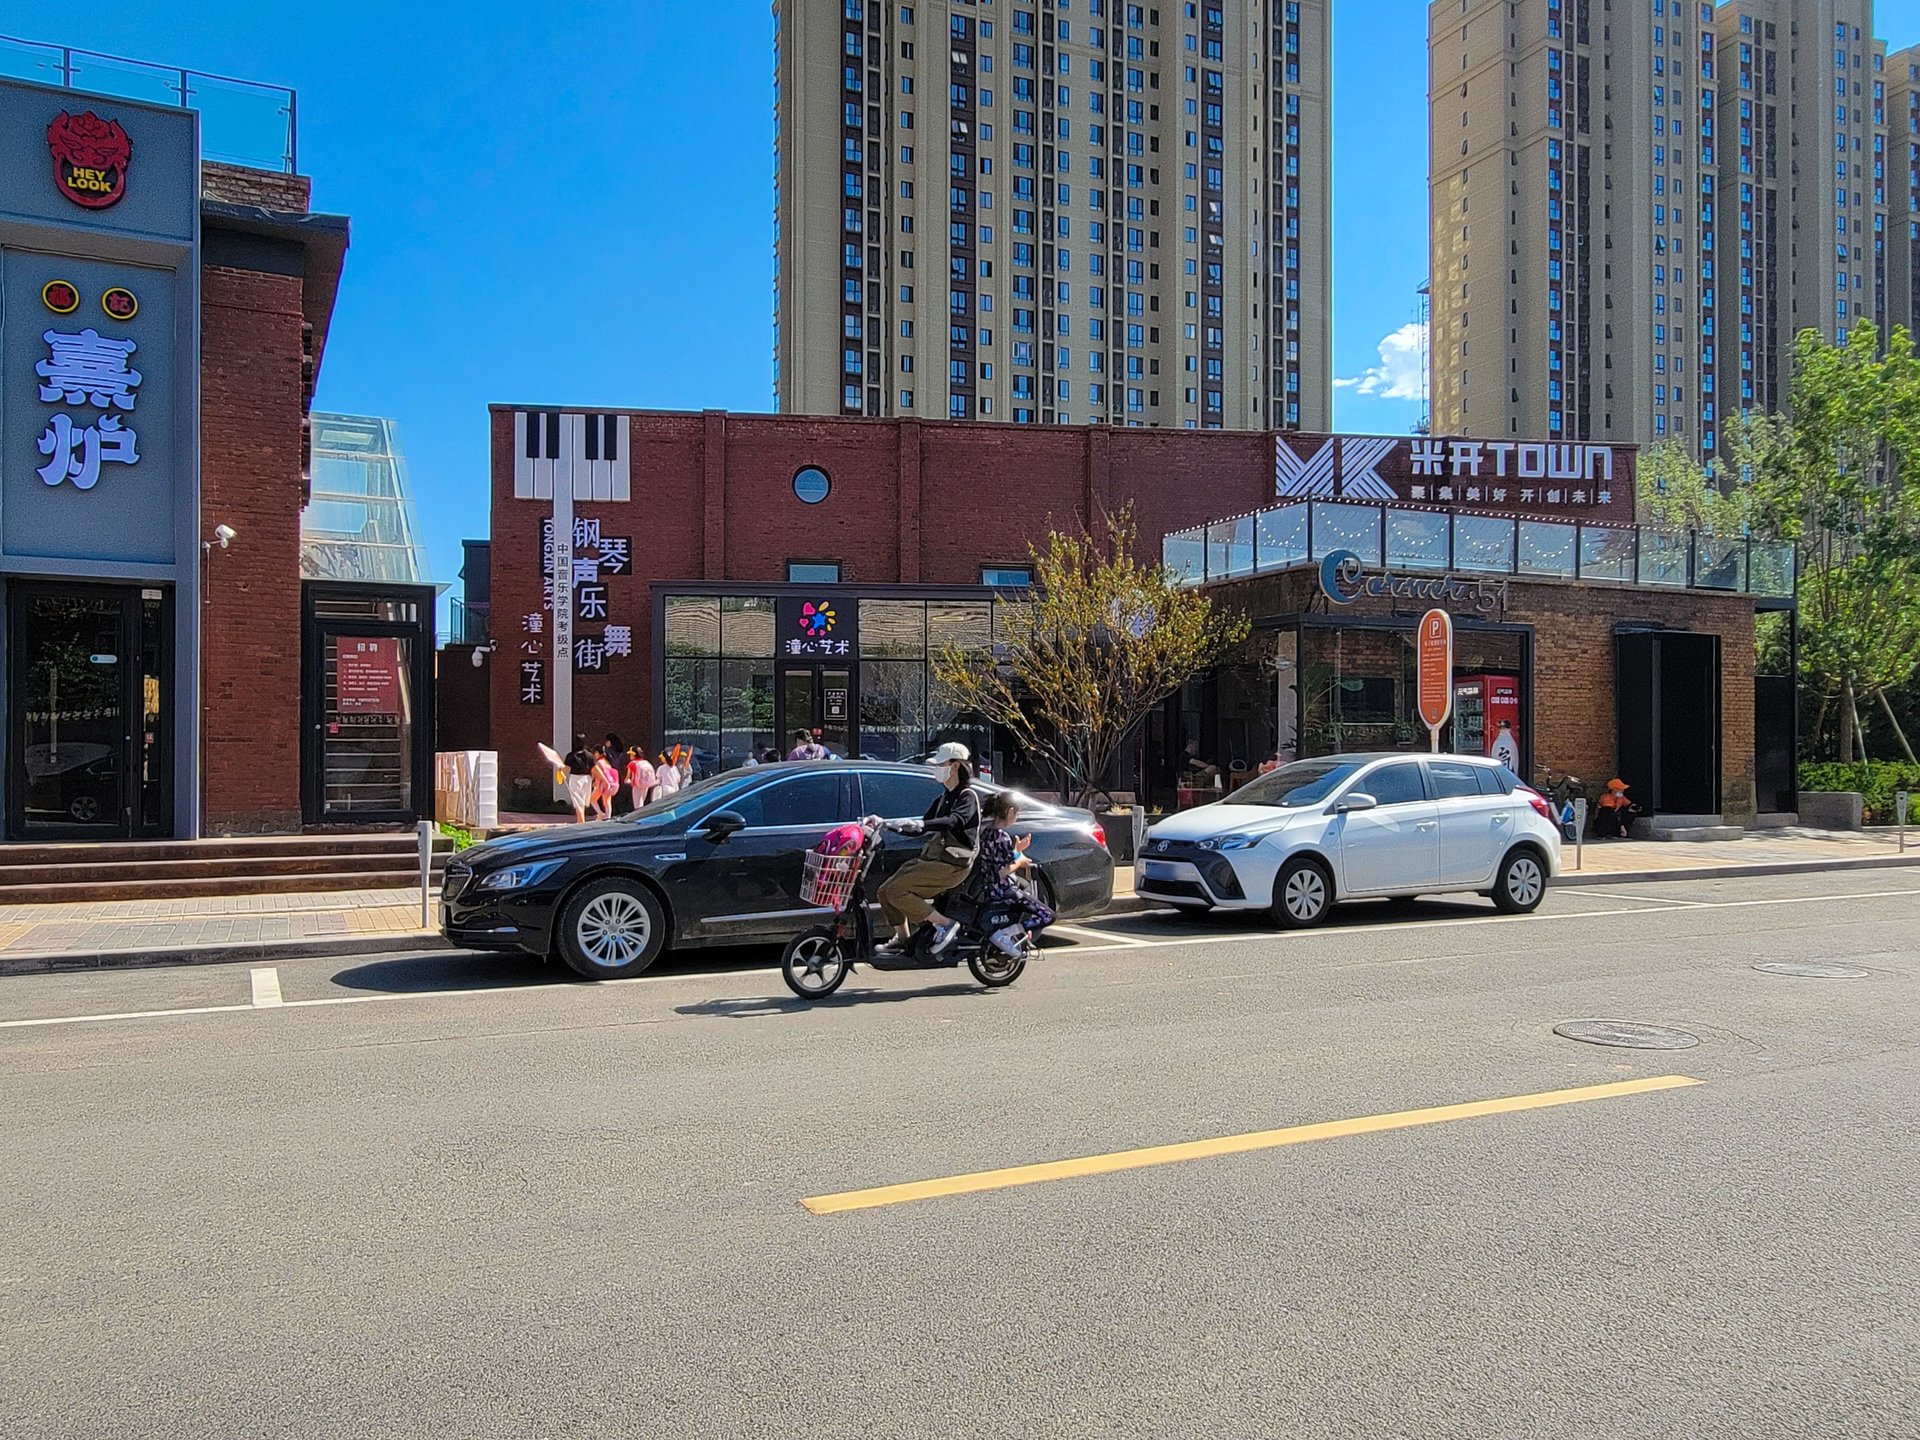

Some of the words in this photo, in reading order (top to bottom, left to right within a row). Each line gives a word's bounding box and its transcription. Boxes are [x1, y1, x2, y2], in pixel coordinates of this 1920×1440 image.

[67, 176, 112, 193] LOOK
[73, 166, 106, 181] HEY
[1275, 435, 1399, 499] MK
[543, 576, 554, 610] ARTS
[556, 542, 570, 659] 中国音乐学院考级点
[785, 639, 850, 655] 潼心艺术
